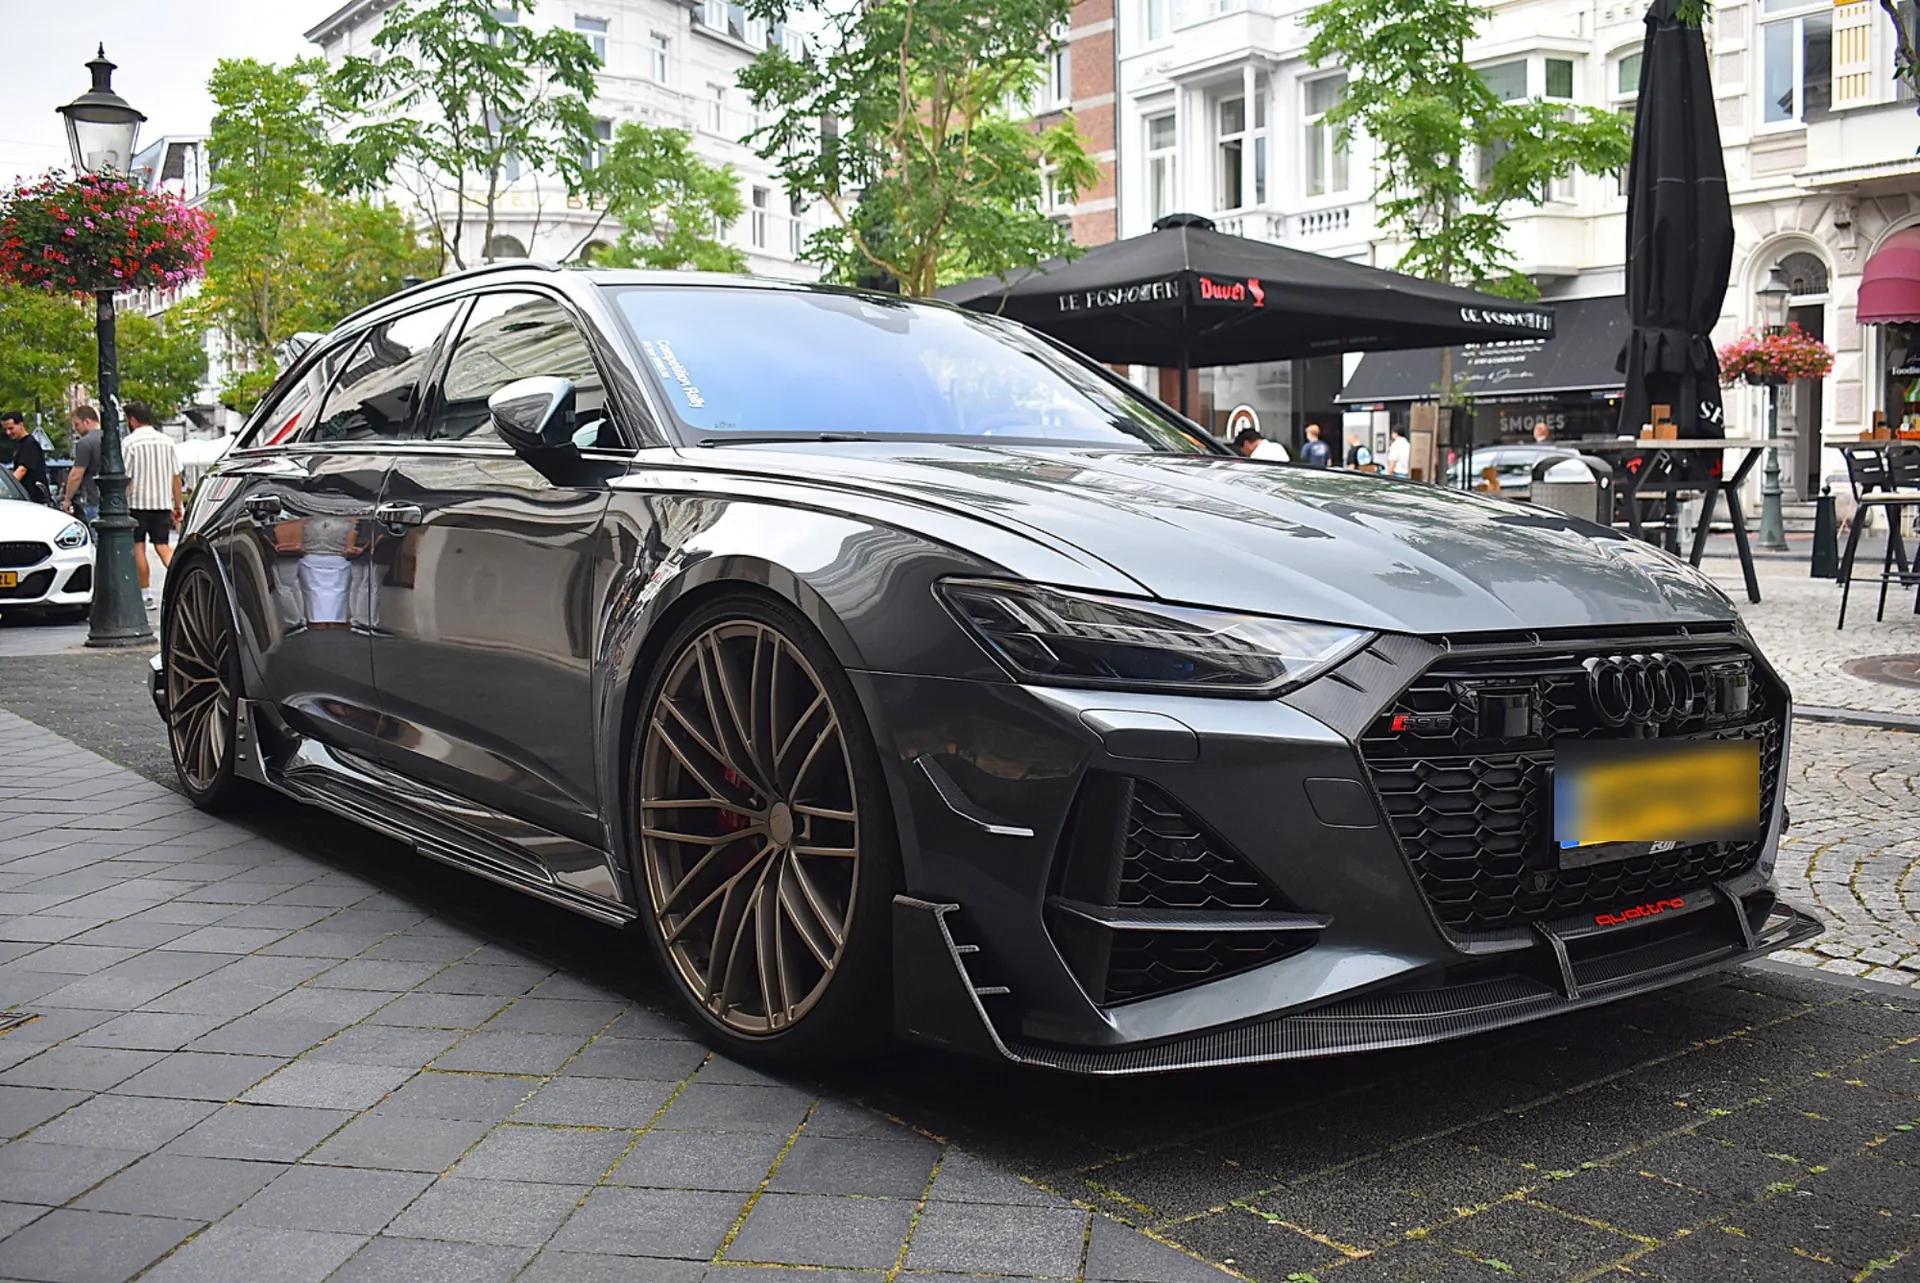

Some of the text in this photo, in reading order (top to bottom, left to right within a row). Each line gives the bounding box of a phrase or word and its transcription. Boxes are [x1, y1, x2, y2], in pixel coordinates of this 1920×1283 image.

[1199, 276, 1247, 301] Duvel
[1059, 294, 1081, 312] DE
[682, 386, 705, 410] Rally
[1594, 897, 1685, 926] quattro
